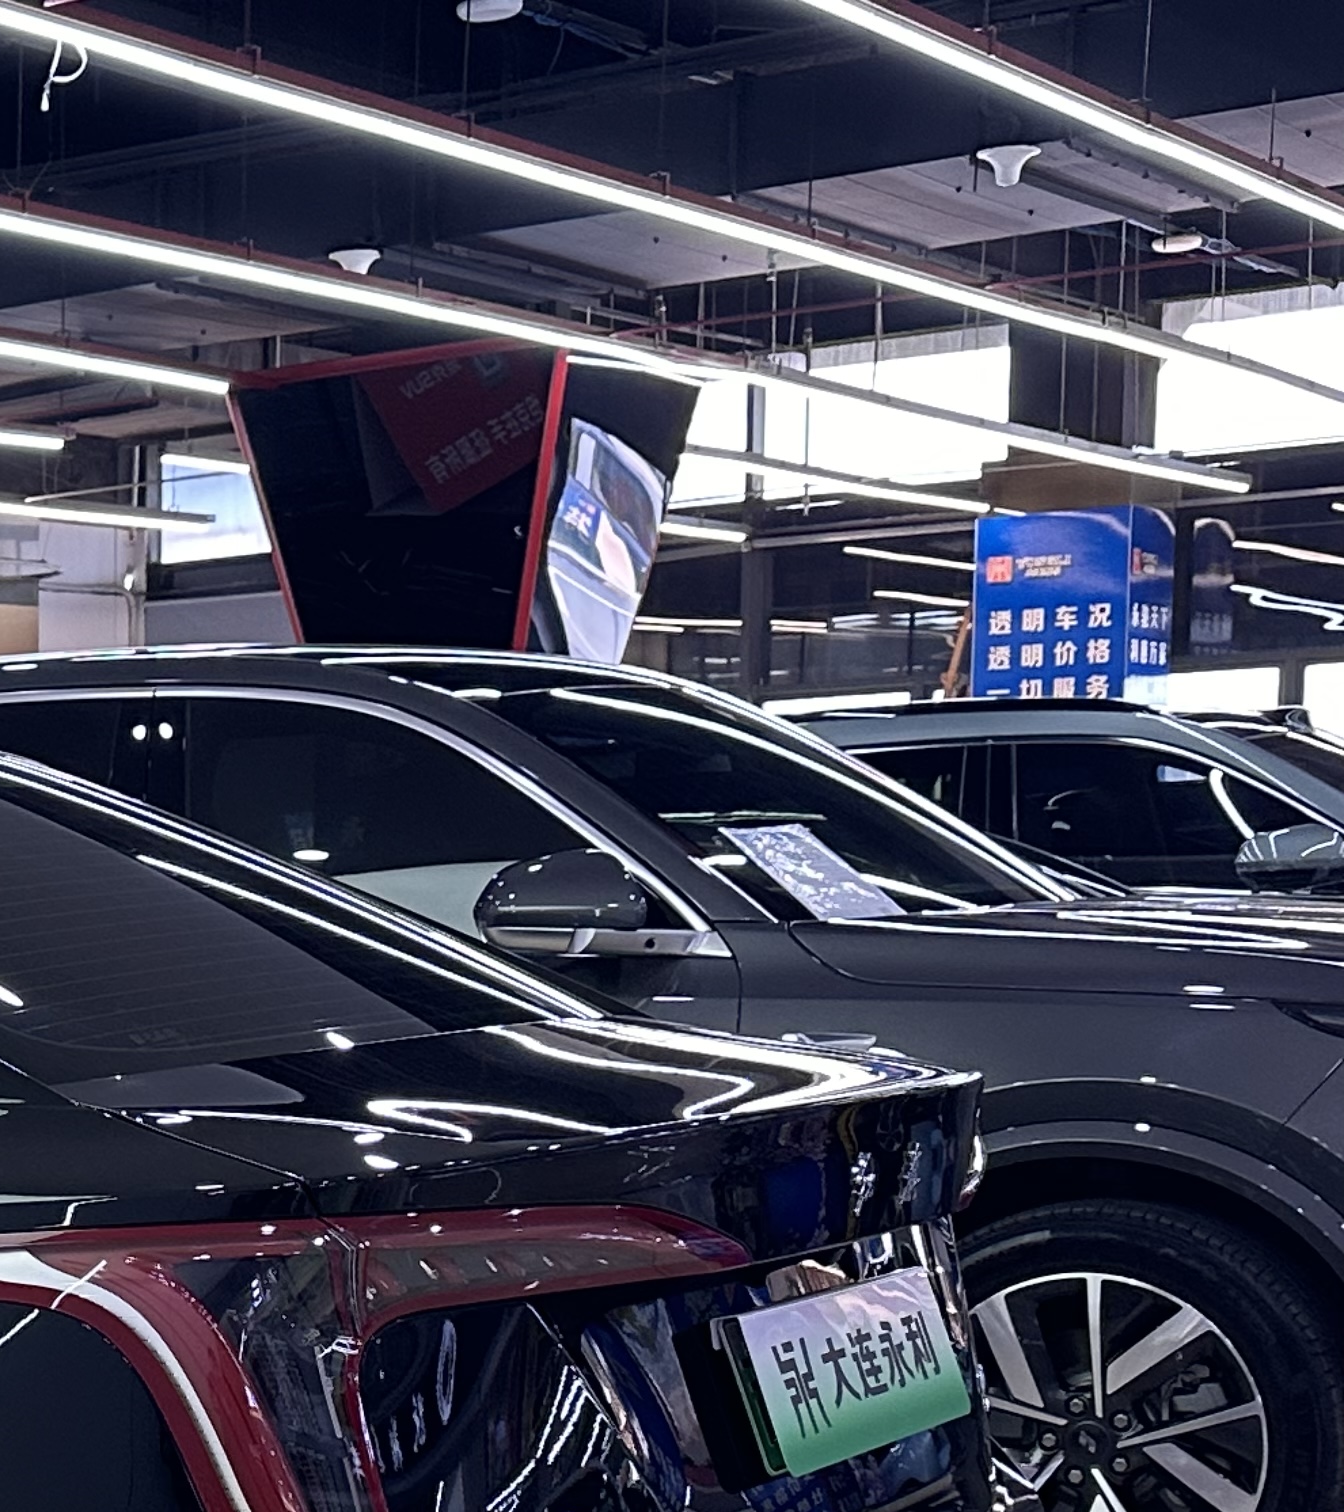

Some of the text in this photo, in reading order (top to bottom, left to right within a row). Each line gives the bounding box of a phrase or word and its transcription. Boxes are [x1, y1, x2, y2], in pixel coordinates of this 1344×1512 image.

[987, 602, 1113, 637] 透明车况
[986, 638, 1112, 672] 透明价格
[985, 674, 1110, 699] 一切服务
[821, 1310, 942, 1409] 大连永利
